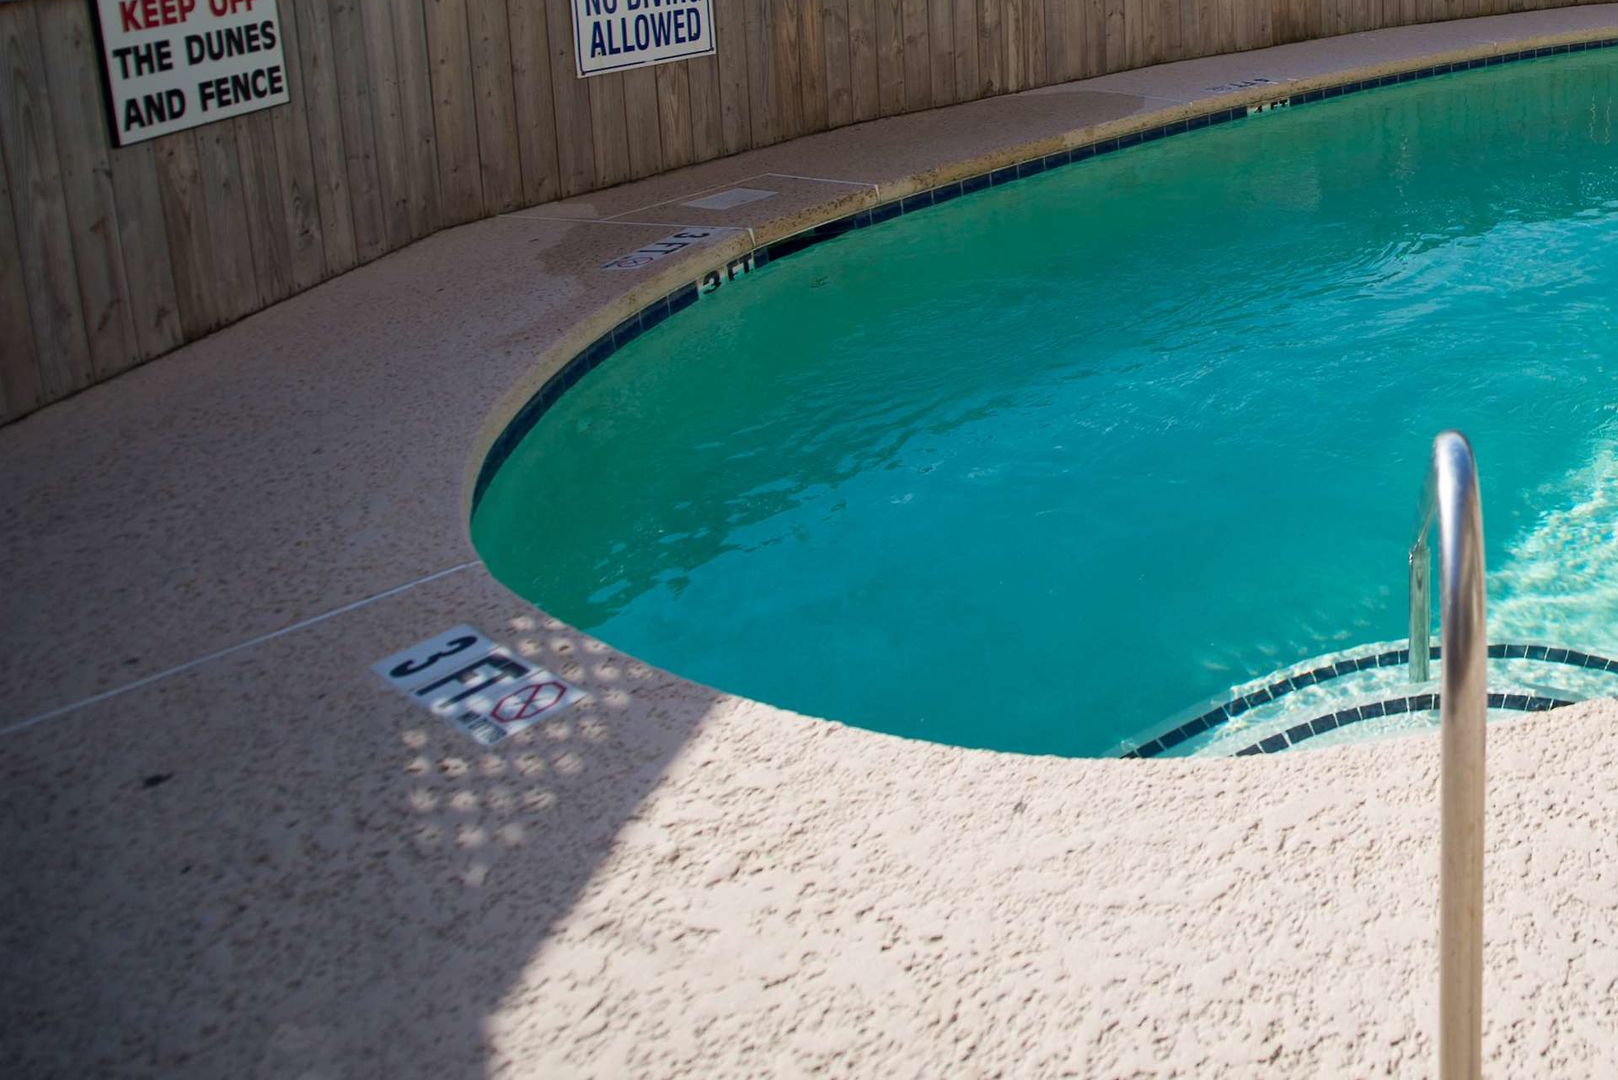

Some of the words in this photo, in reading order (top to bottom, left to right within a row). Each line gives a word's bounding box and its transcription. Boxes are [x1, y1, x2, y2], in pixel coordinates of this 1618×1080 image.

[112, 40, 173, 80] THE
[184, 21, 276, 66] DUNES
[591, 8, 701, 58] ALLOWED
[124, 89, 186, 132] AND
[198, 66, 284, 112] FENCE
[637, 242, 691, 255] FT
[726, 252, 753, 281] FT
[389, 636, 478, 678] 3
[416, 654, 530, 709] FT
